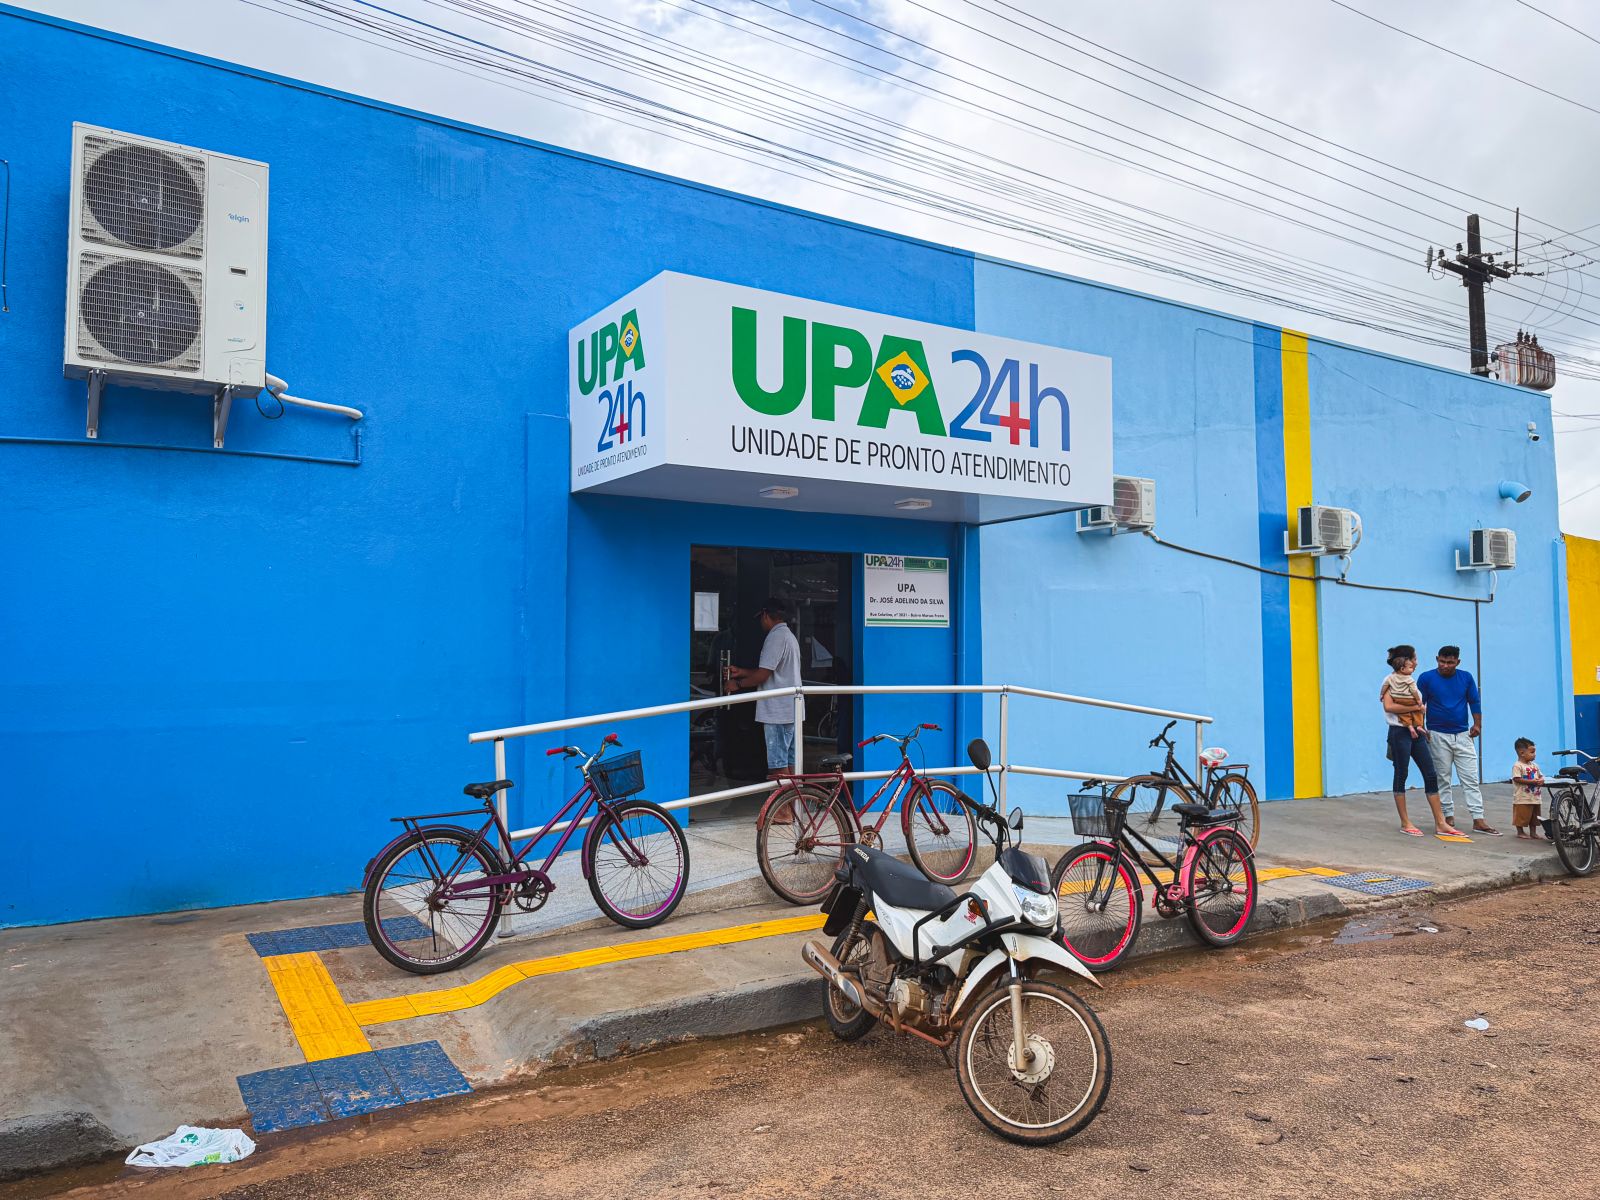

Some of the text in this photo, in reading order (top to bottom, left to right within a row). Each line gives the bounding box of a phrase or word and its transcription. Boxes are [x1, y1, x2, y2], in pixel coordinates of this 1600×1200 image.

[577, 308, 646, 396] UPA
[731, 305, 1071, 452] UPA 24h
[597, 379, 646, 453] 24h
[577, 444, 648, 477] UNIDADE DE PRONTO ATENDIMENTO
[731, 424, 1072, 486] UNIDADE DE PRONTO ATENDIMENTO
[879, 595, 894, 604] JOSÉ
[894, 597, 919, 605] ADELINO
[897, 583, 917, 593] UPA
[853, 847, 870, 863] HONDA
